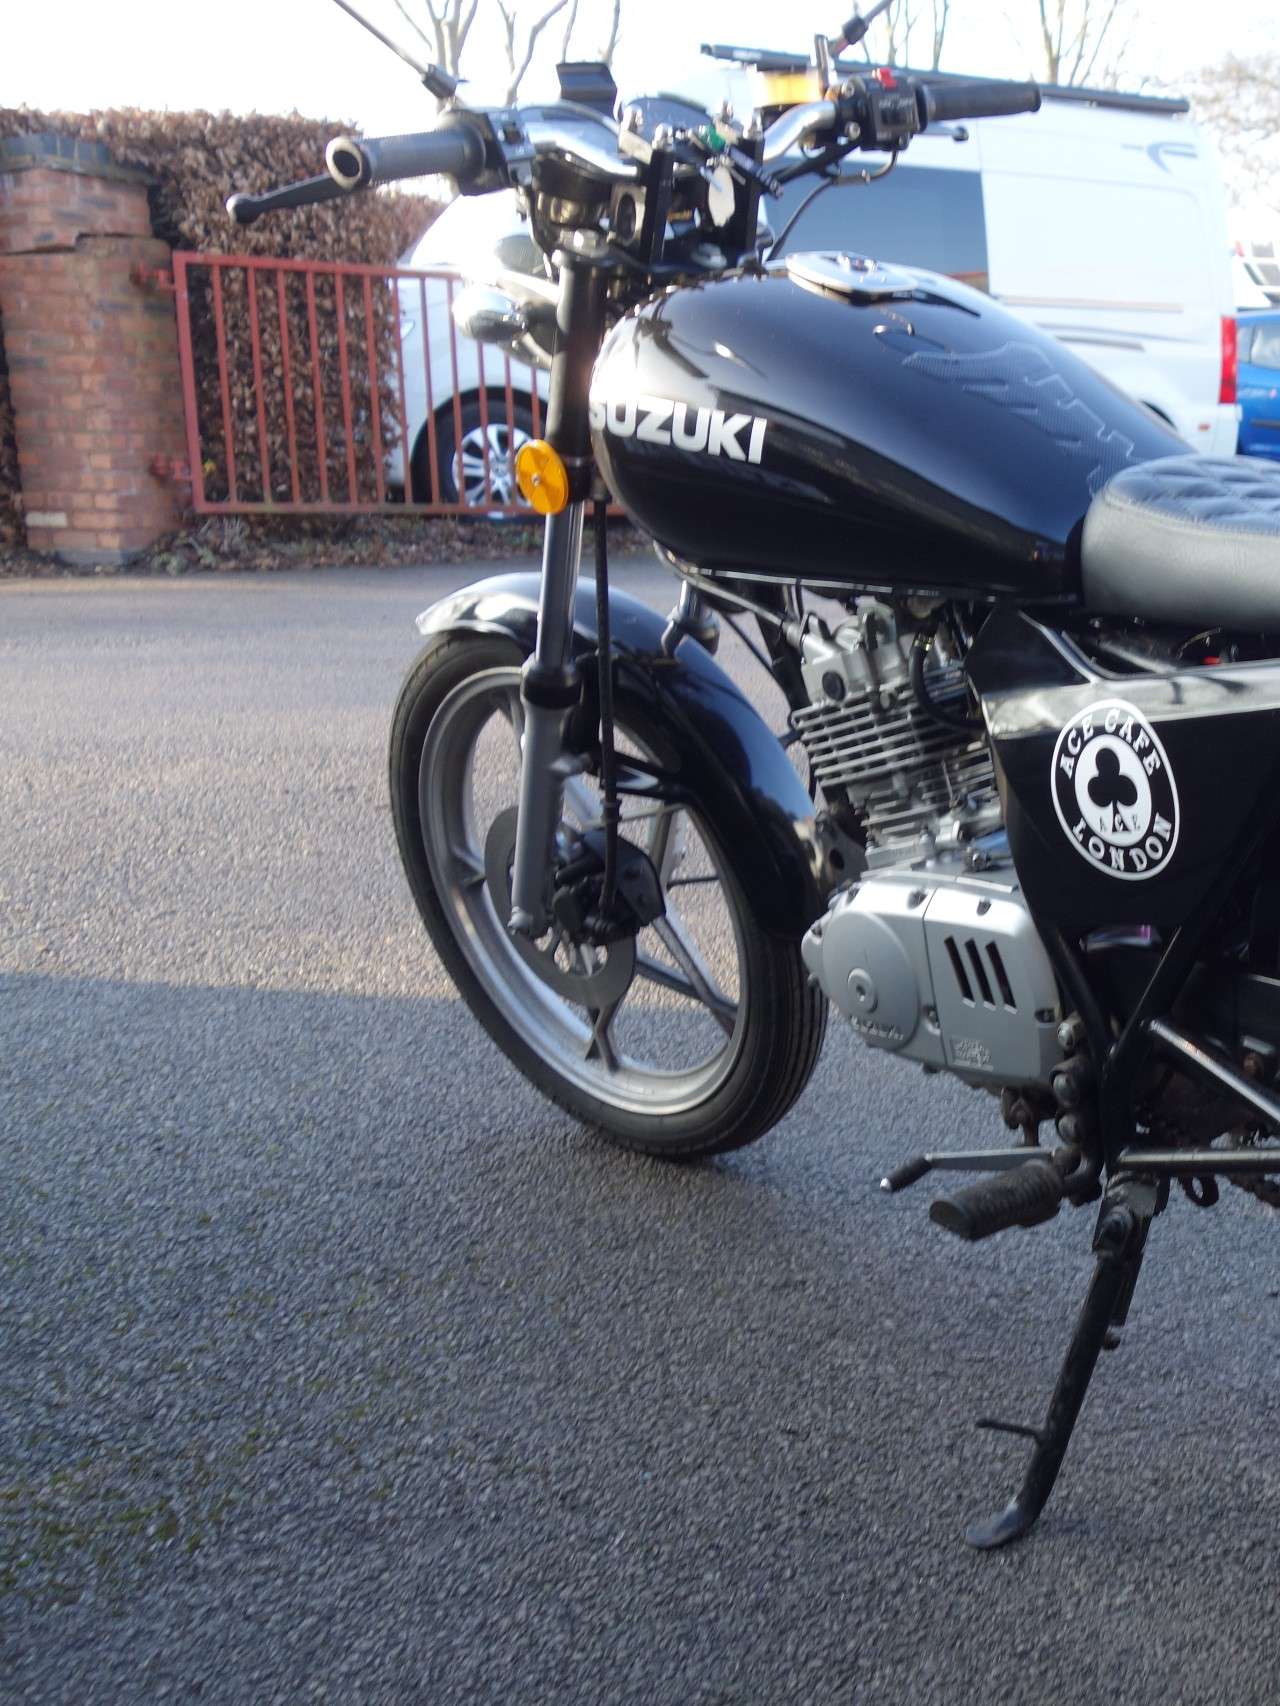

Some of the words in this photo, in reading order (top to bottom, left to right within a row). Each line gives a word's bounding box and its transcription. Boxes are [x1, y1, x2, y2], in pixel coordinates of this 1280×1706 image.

[1060, 714, 1094, 778] ACE
[1105, 708, 1161, 776] CAFE
[1073, 813, 1172, 871] LONDON
